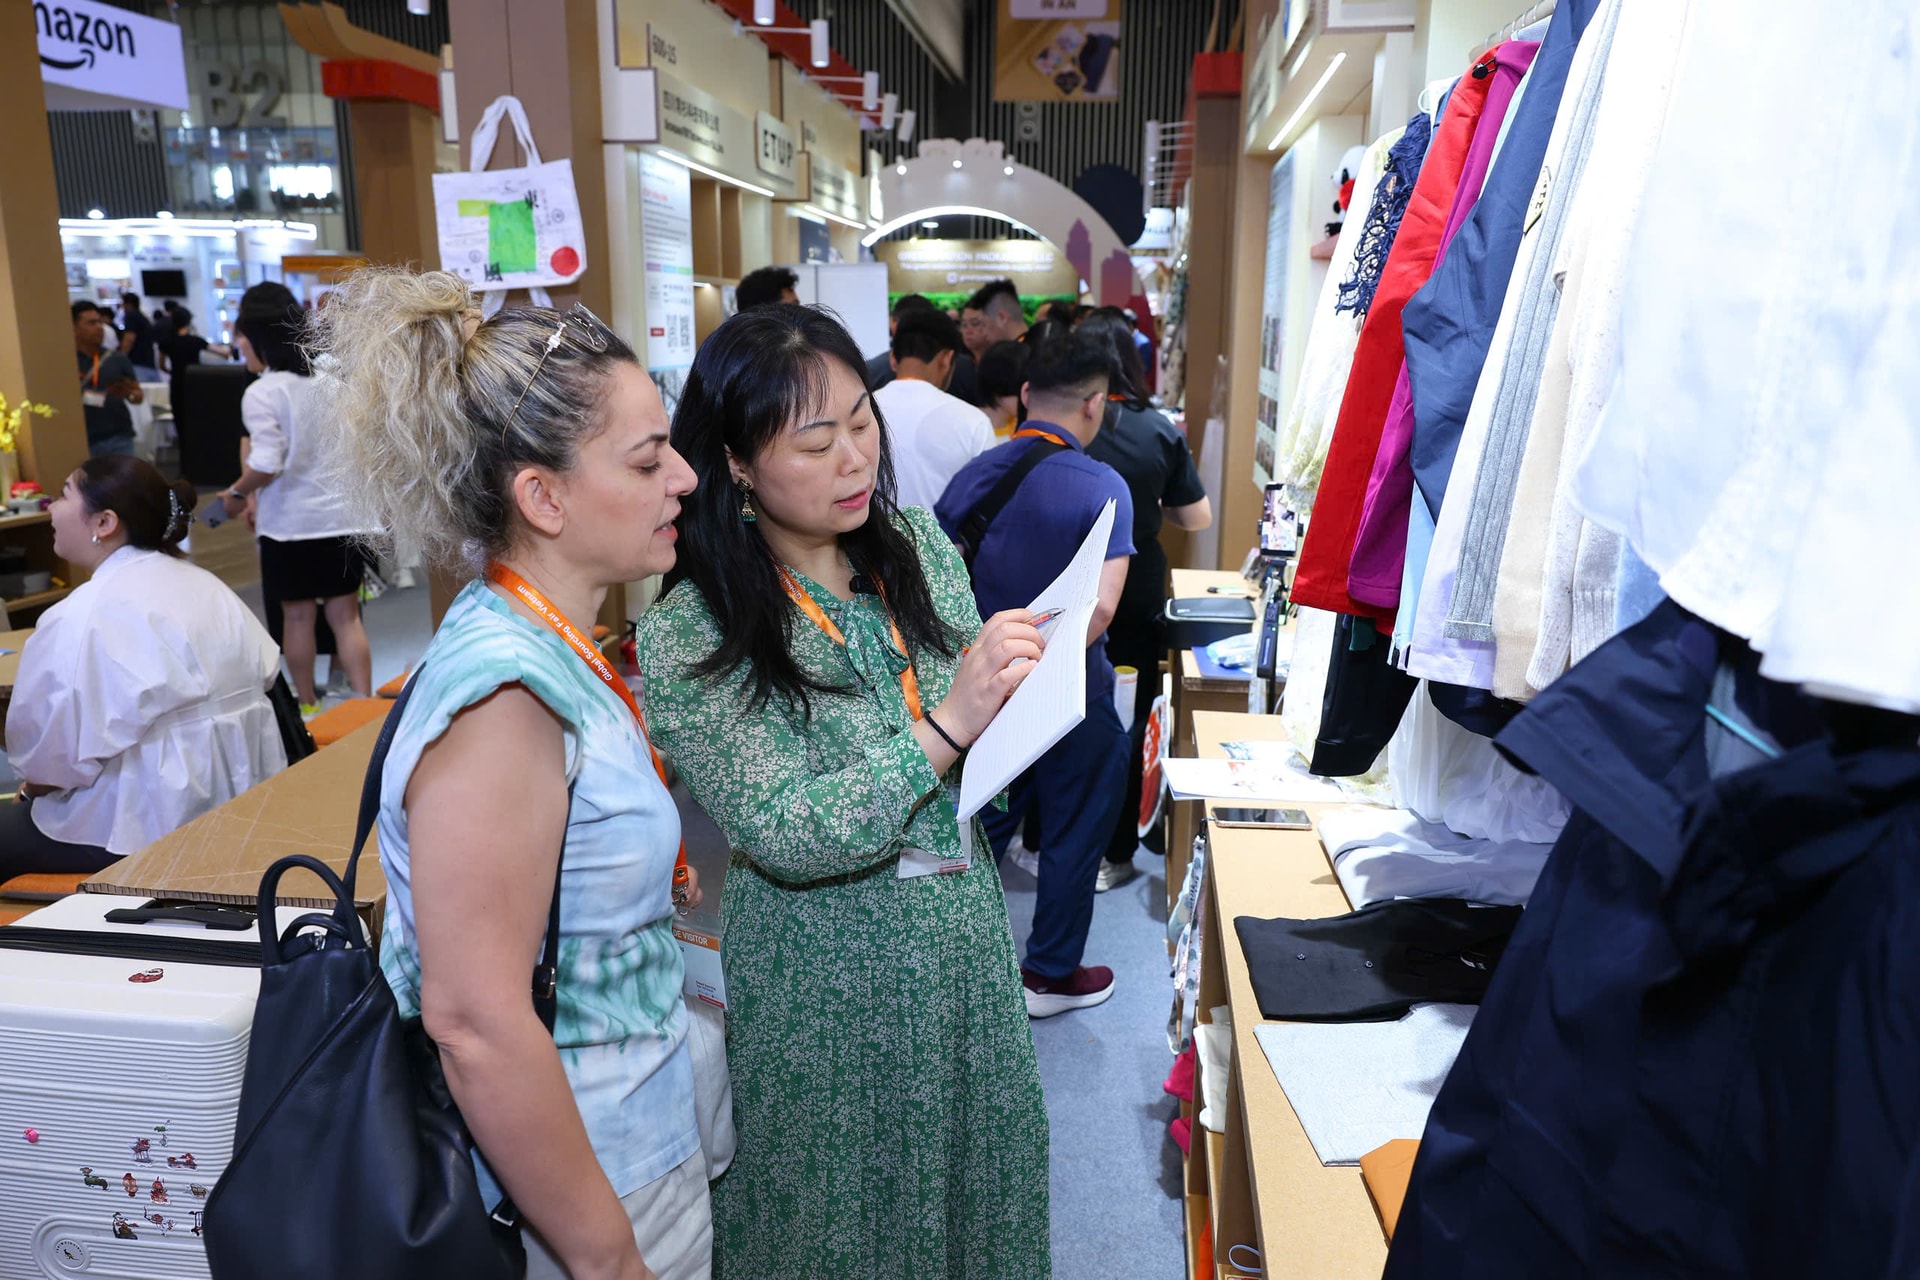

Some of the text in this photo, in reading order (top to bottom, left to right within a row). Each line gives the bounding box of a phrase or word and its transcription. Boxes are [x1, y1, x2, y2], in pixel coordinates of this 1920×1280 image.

[200, 60, 287, 127] B2
[763, 129, 793, 168] ETUP
[784, 579, 802, 600] Global
[517, 585, 613, 681] Global Sourcing Fair Vietnam
[682, 932, 708, 945] VISITOR
